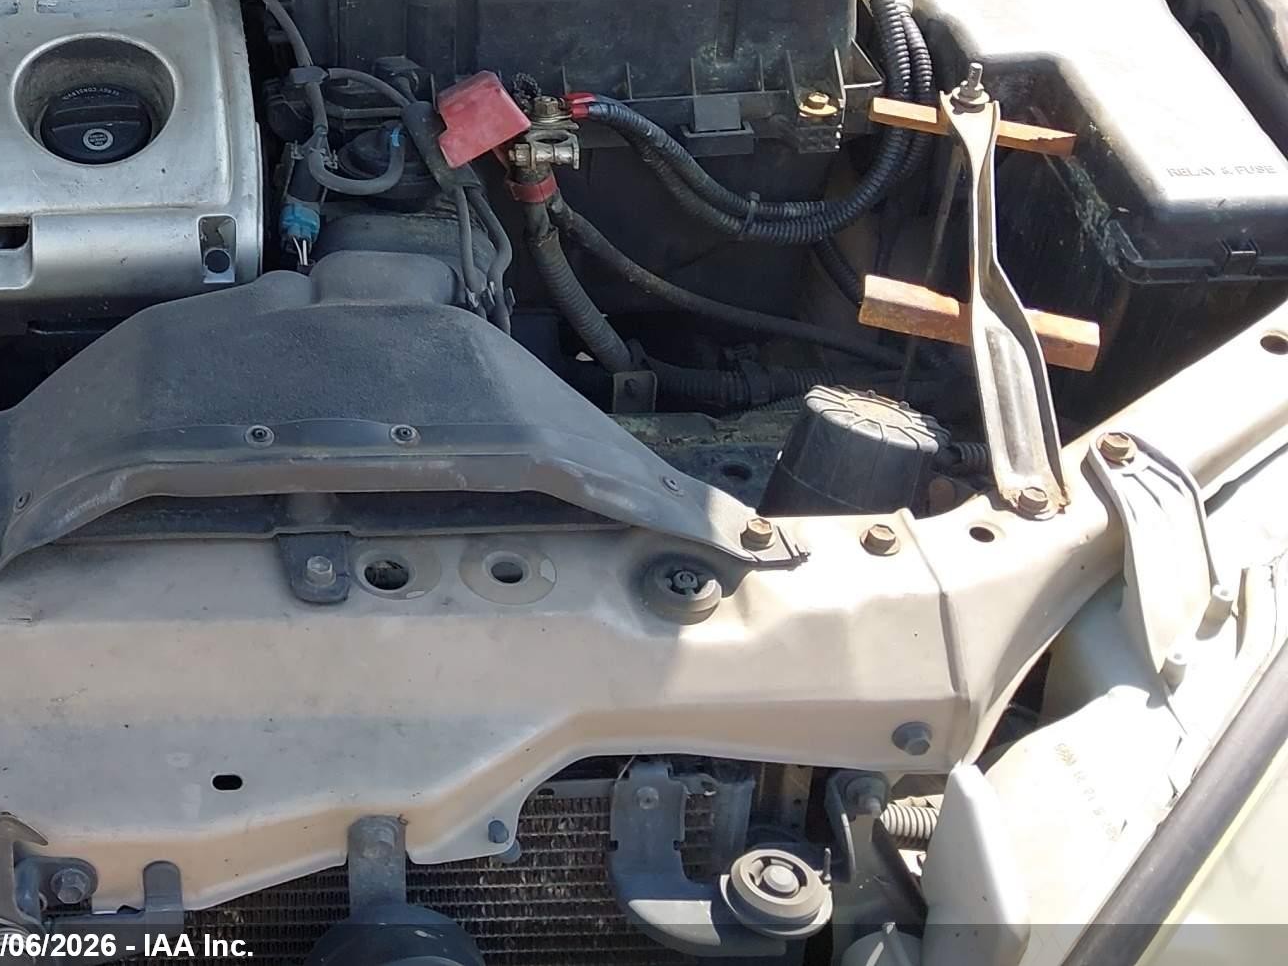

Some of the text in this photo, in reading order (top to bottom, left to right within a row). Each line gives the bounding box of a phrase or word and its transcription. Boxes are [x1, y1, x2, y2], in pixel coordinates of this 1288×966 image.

[1166, 165, 1278, 177] RELAY & FUSE
